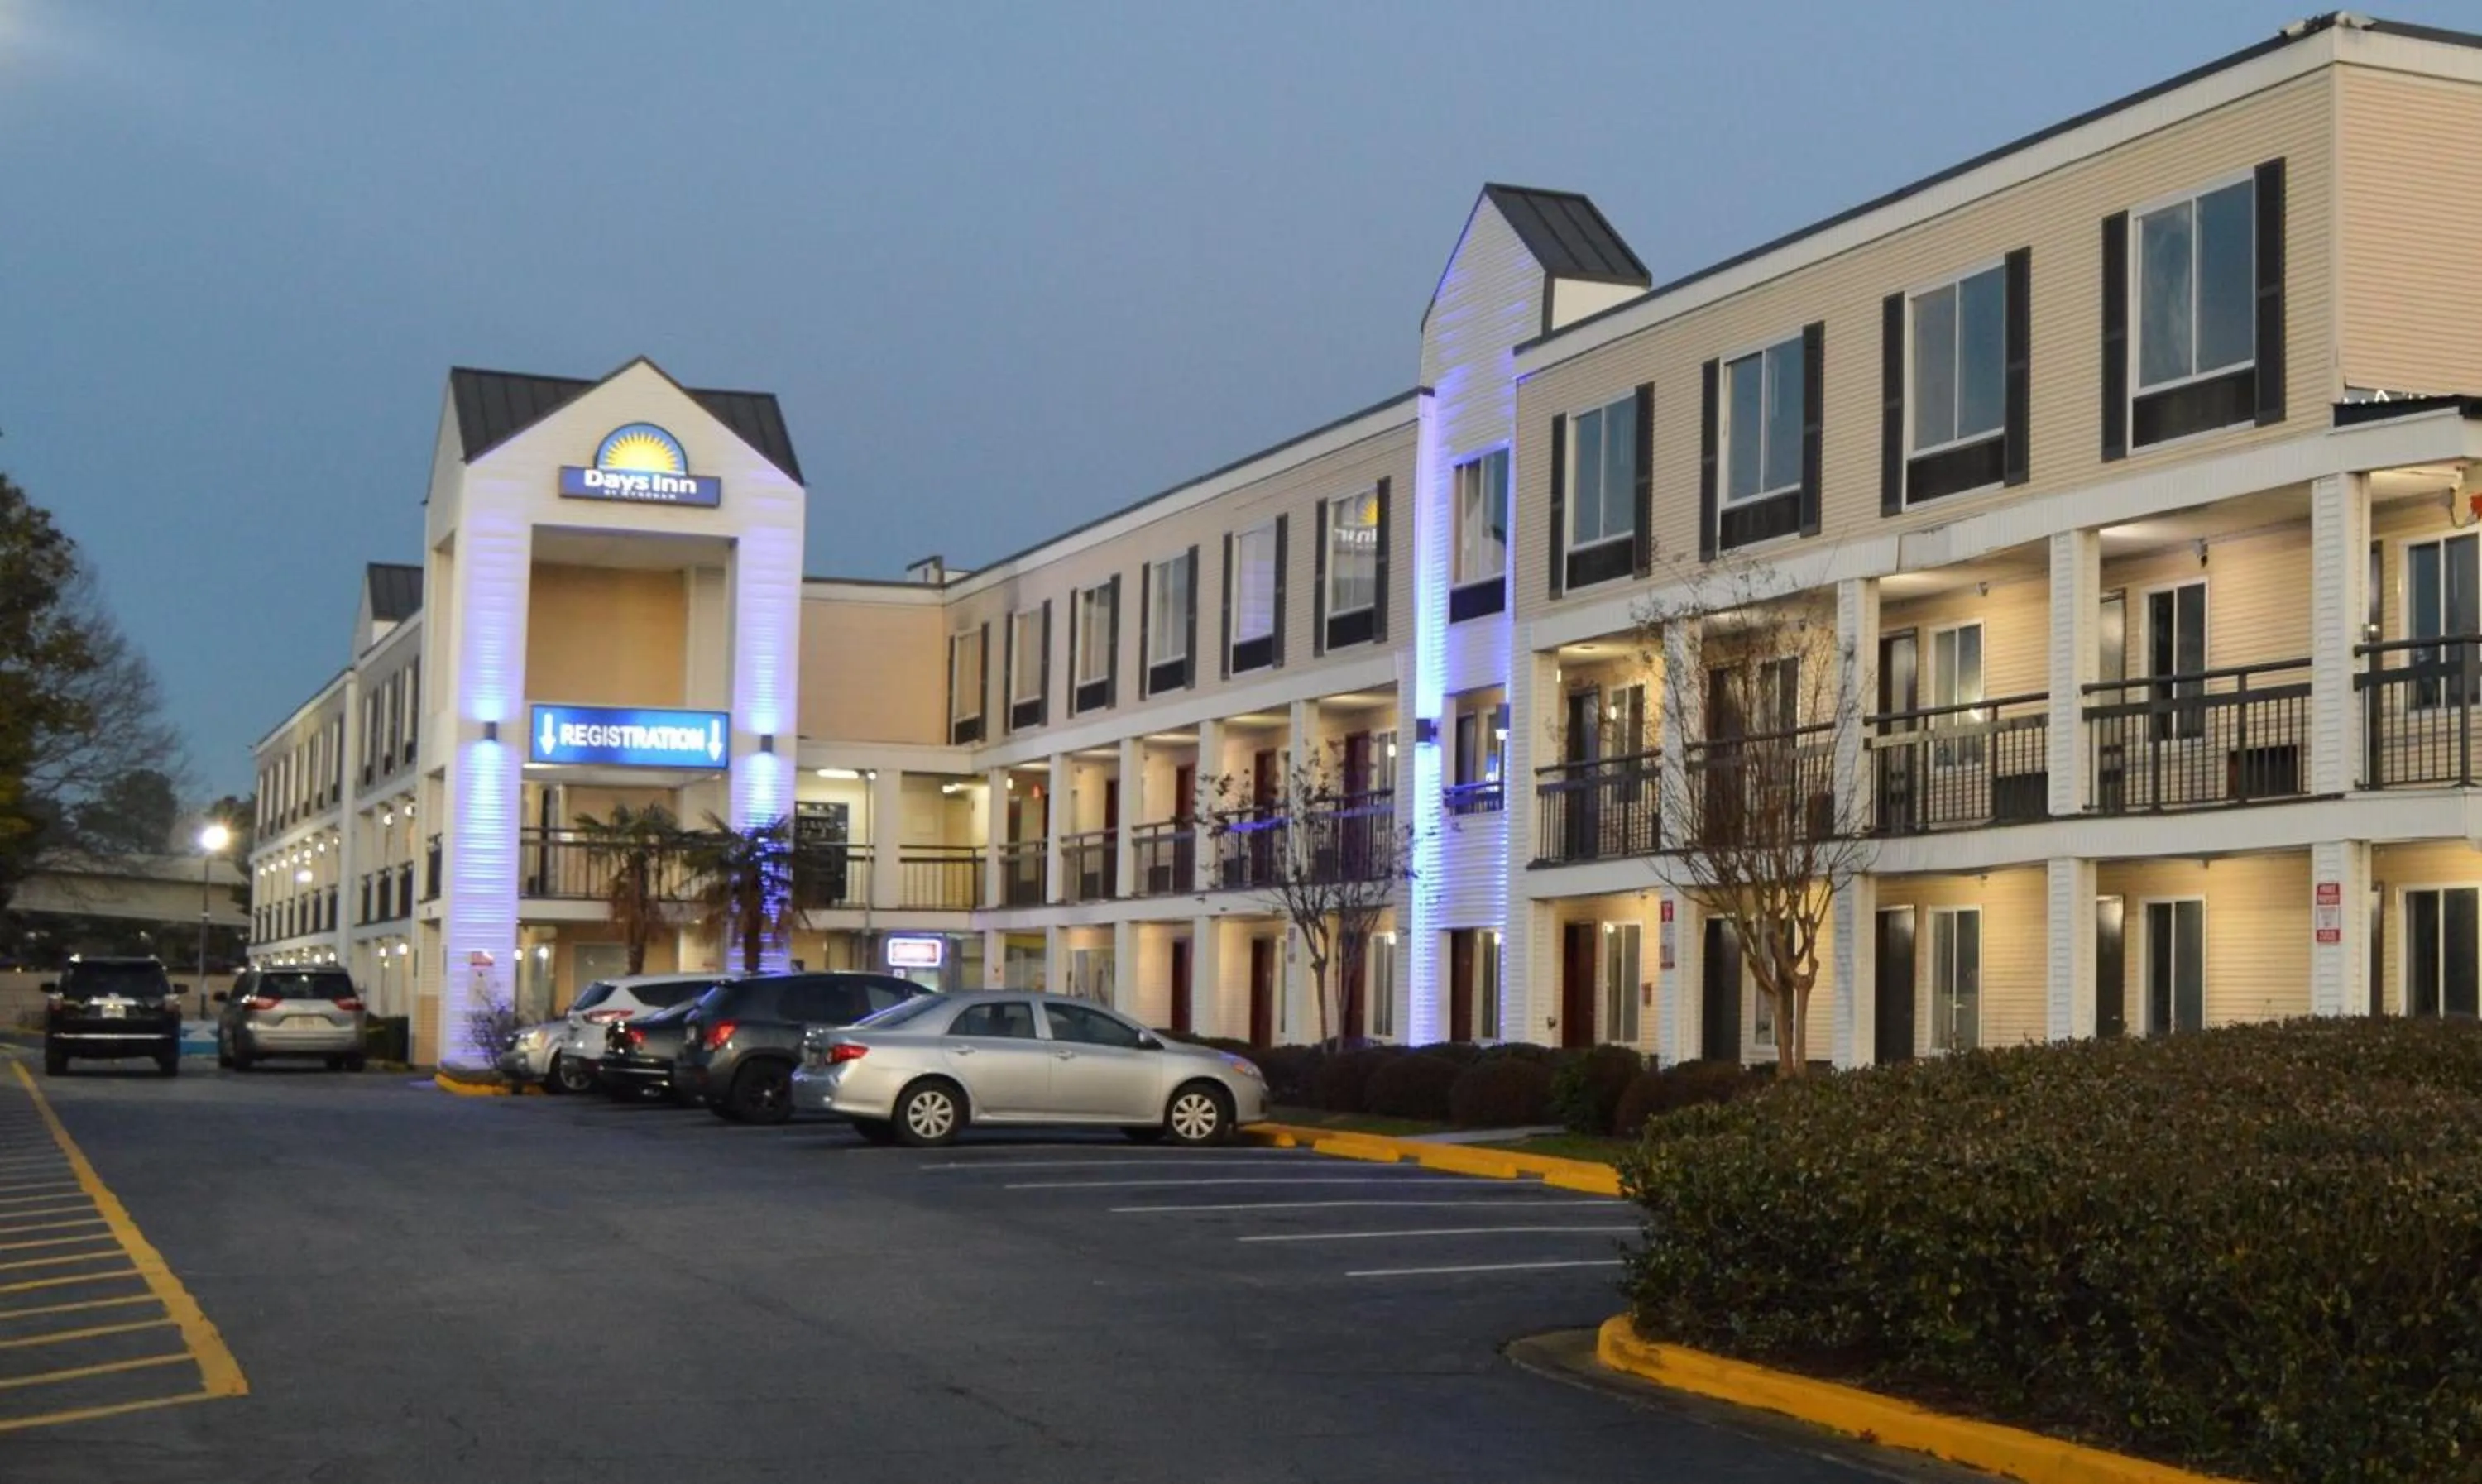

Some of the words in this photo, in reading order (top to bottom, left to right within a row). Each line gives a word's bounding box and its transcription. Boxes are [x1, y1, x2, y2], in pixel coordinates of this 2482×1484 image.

[584, 469, 649, 491] Days
[652, 474, 697, 495] Inn
[559, 722, 706, 752] REGISTRATION
